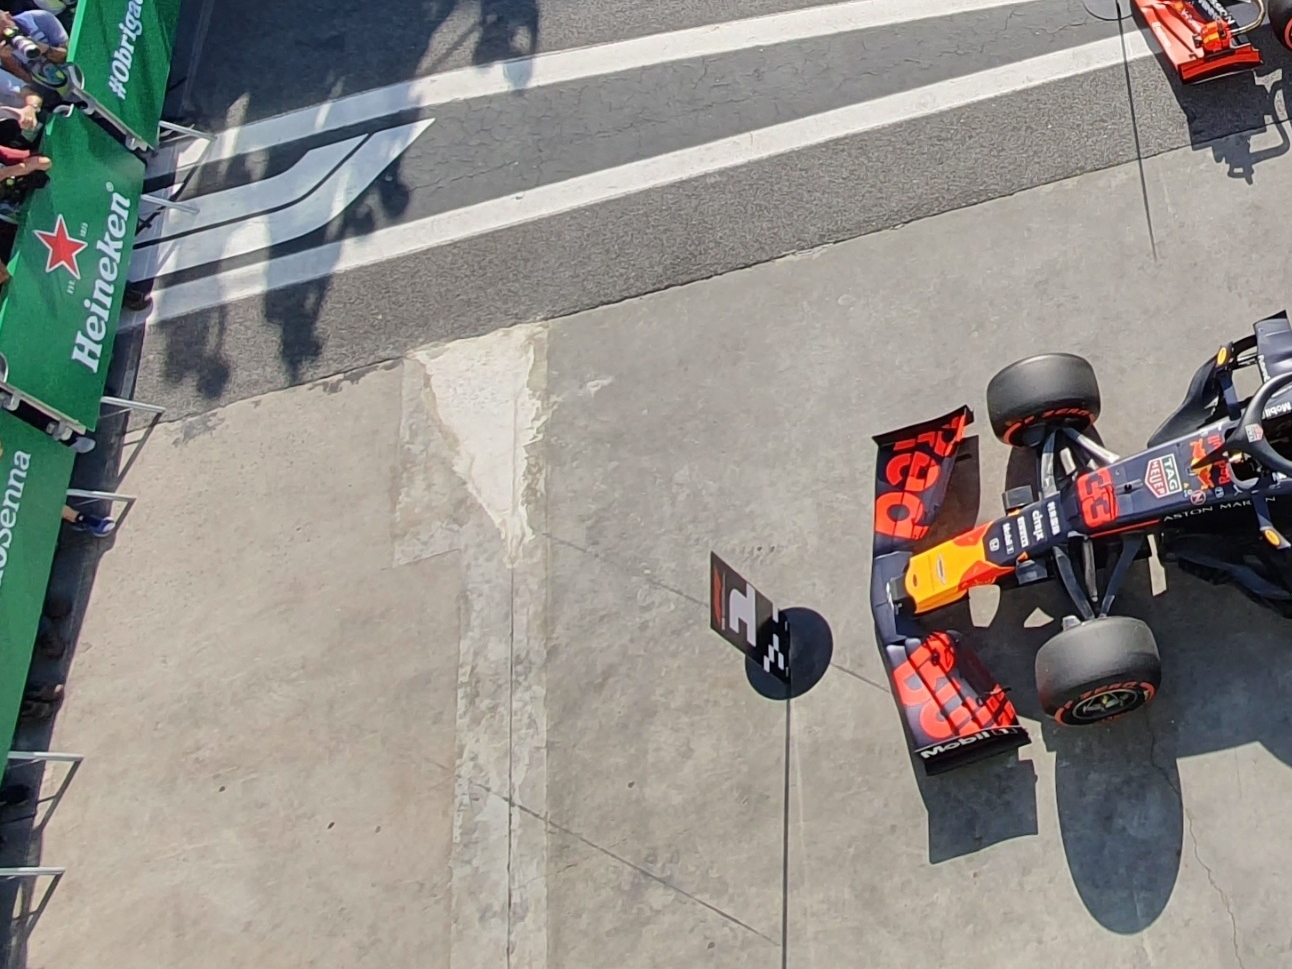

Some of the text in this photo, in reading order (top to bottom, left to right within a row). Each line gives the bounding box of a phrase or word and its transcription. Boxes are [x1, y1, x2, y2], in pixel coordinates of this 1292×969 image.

[71, 191, 131, 373] Heineken
[1149, 461, 1168, 496] HEUER
[1163, 455, 1177, 492] TAG
[1076, 466, 1119, 528] 33
[1163, 496, 1276, 523] ASTON MARN
[920, 729, 990, 760] Mobil
